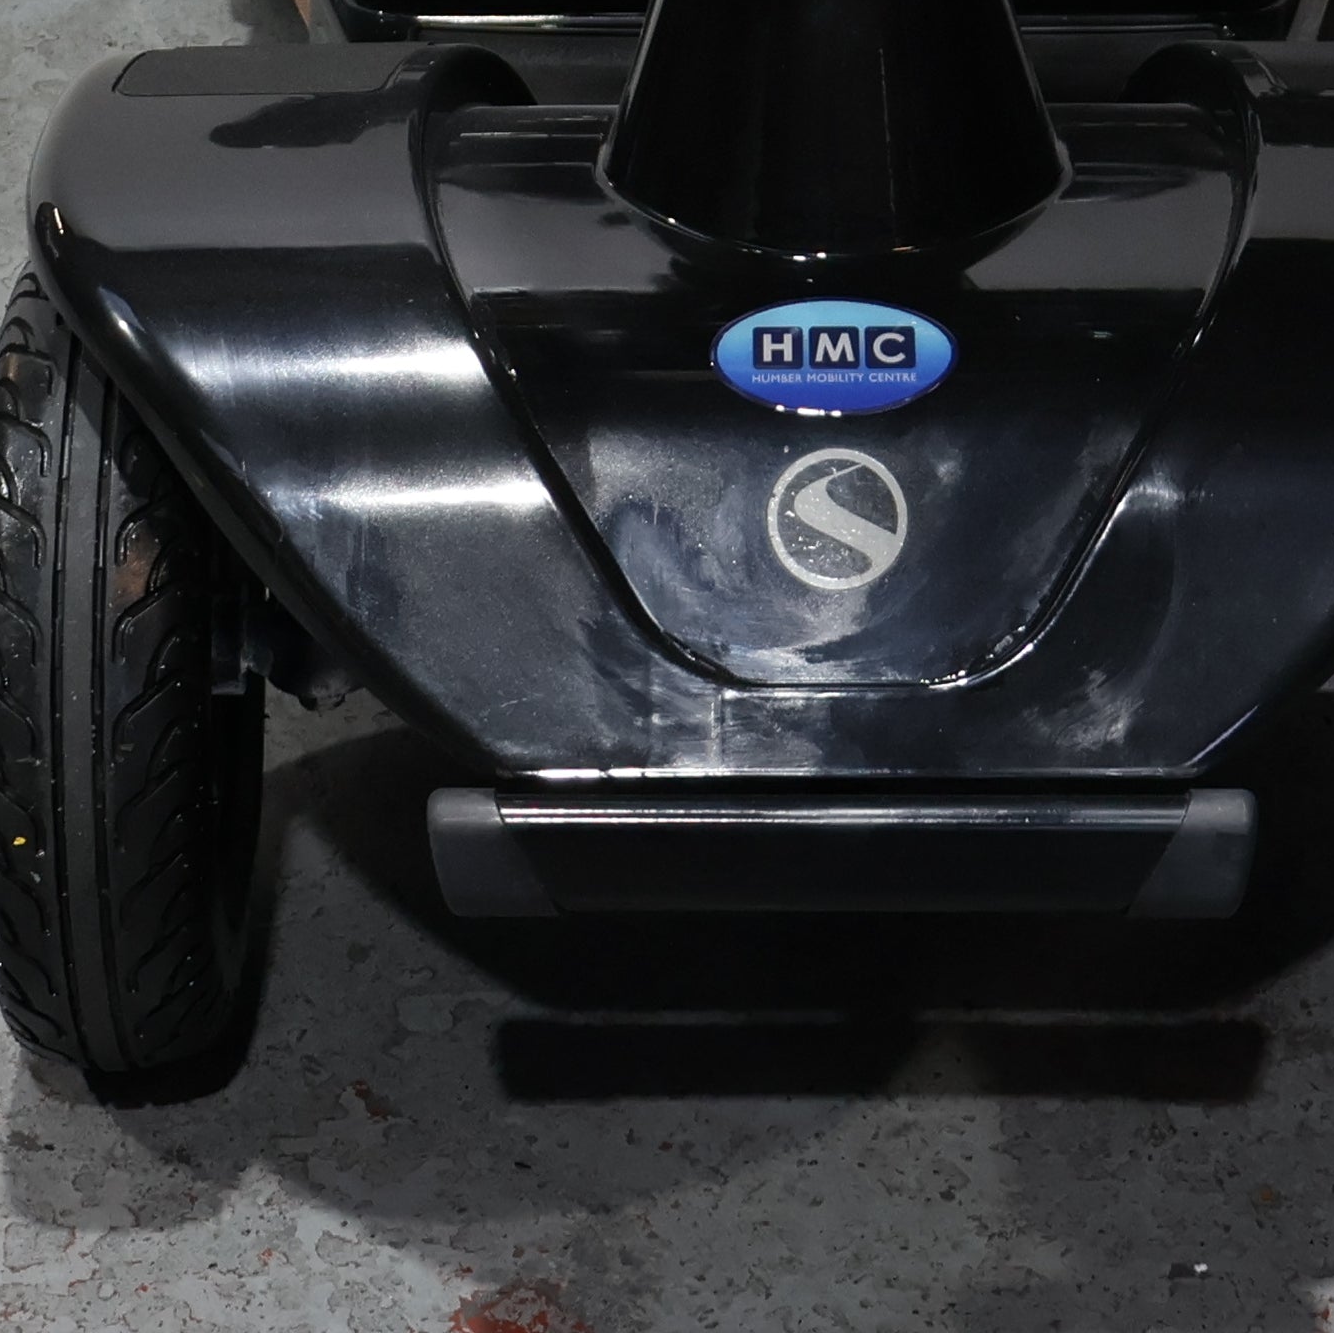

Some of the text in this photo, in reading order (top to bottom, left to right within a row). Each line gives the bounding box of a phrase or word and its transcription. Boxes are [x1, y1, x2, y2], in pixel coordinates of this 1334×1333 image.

[762, 332, 906, 364] HMC
[751, 372, 917, 384] HUMBER MOBILITY CENTRE
